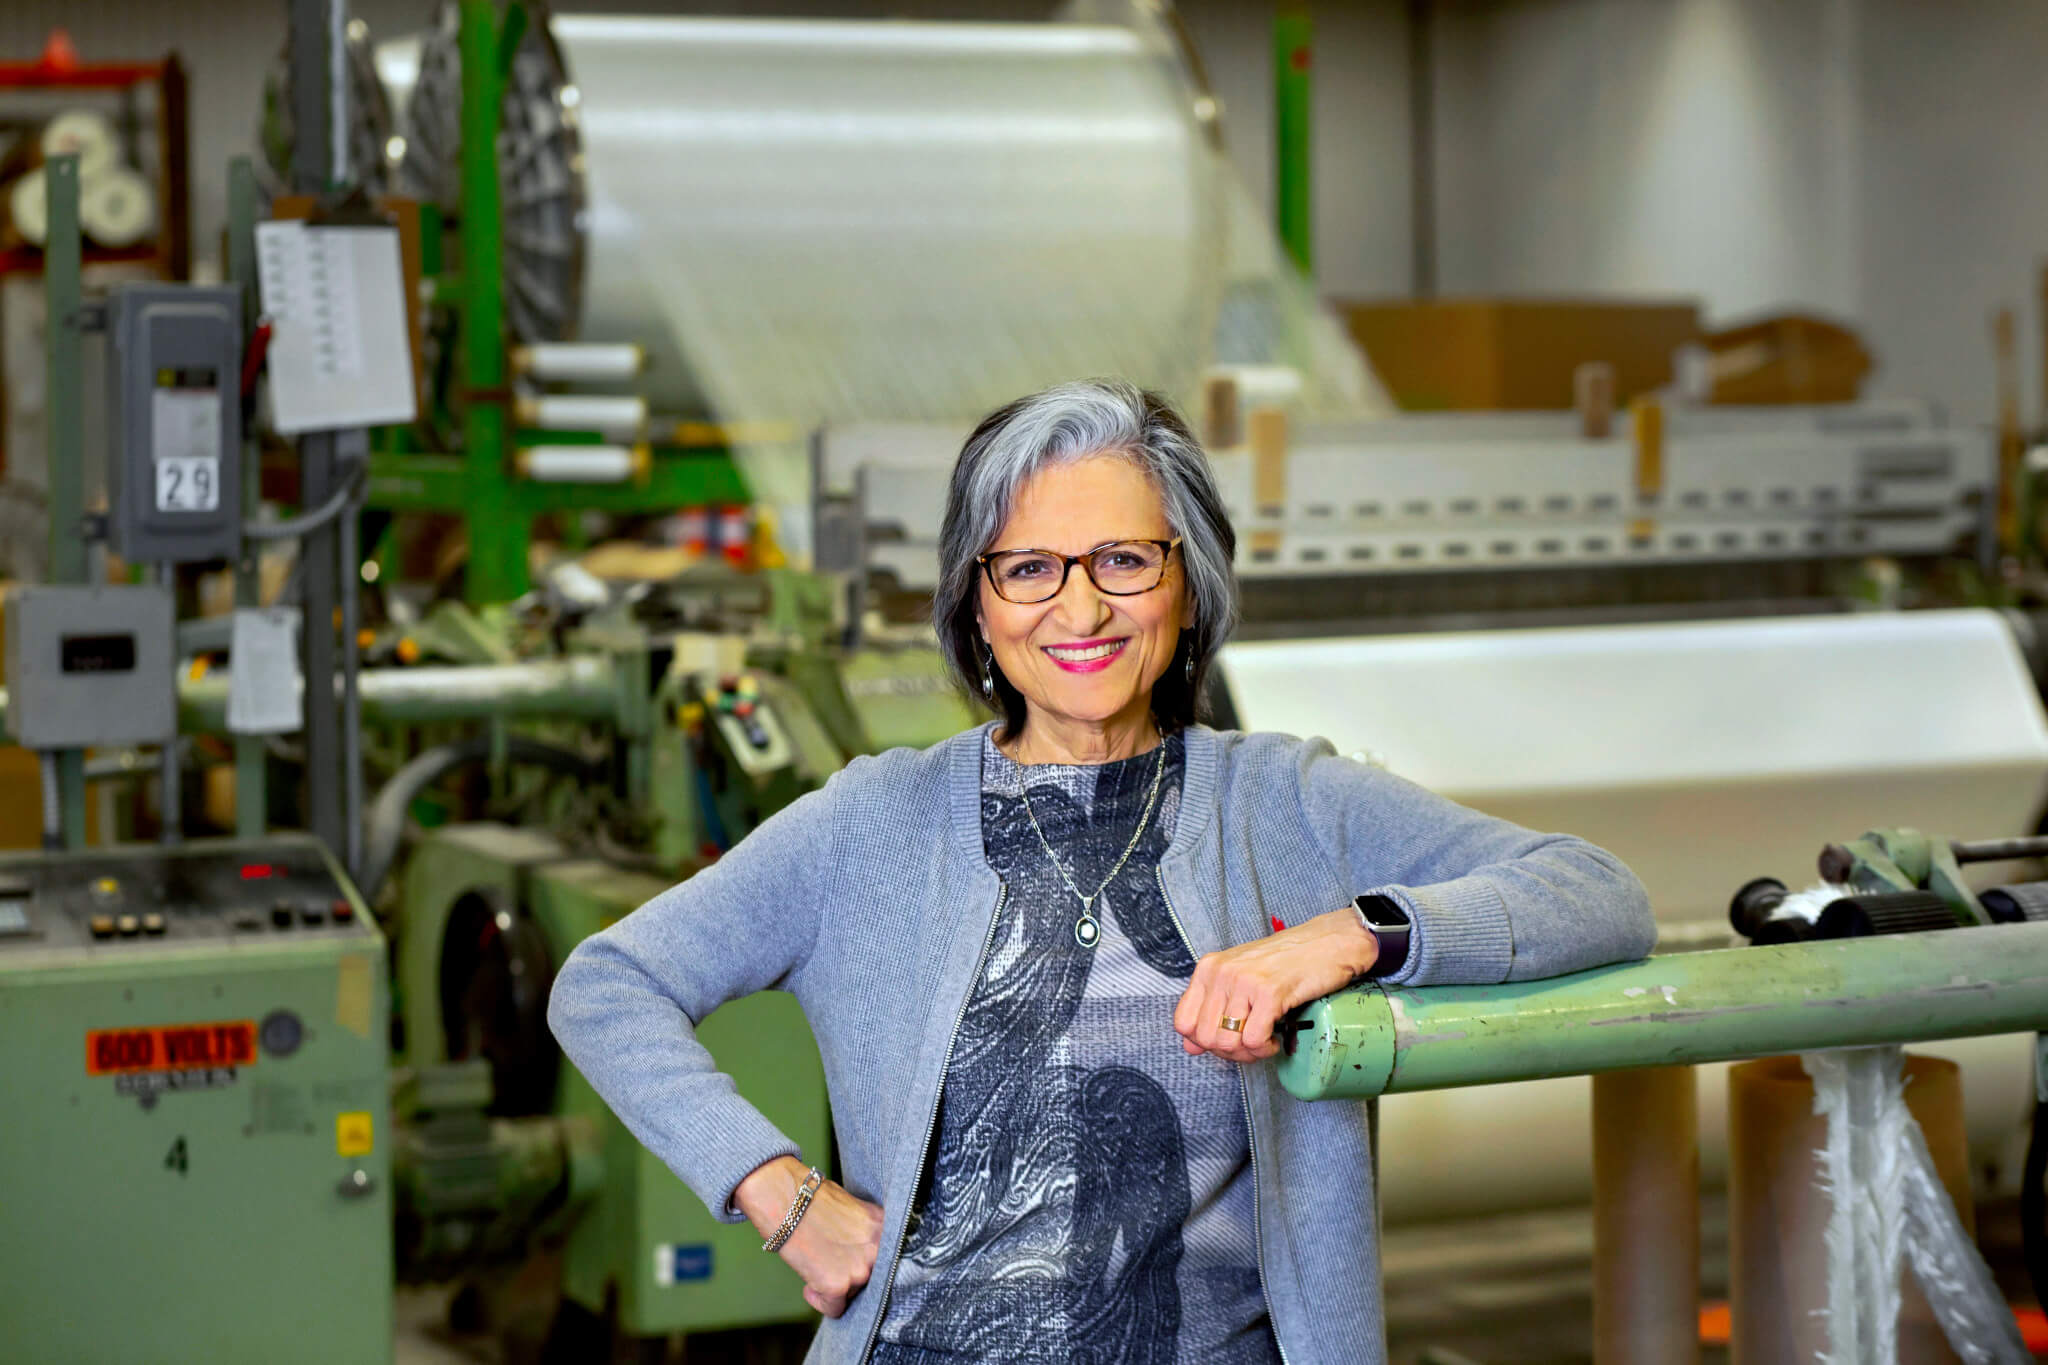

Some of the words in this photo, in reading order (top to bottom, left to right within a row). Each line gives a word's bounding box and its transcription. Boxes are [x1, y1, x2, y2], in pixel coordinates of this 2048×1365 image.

[166, 464, 210, 508] 29
[96, 1032, 153, 1071] 600
[163, 1025, 249, 1065] VOLTS
[164, 1135, 188, 1178] 4
